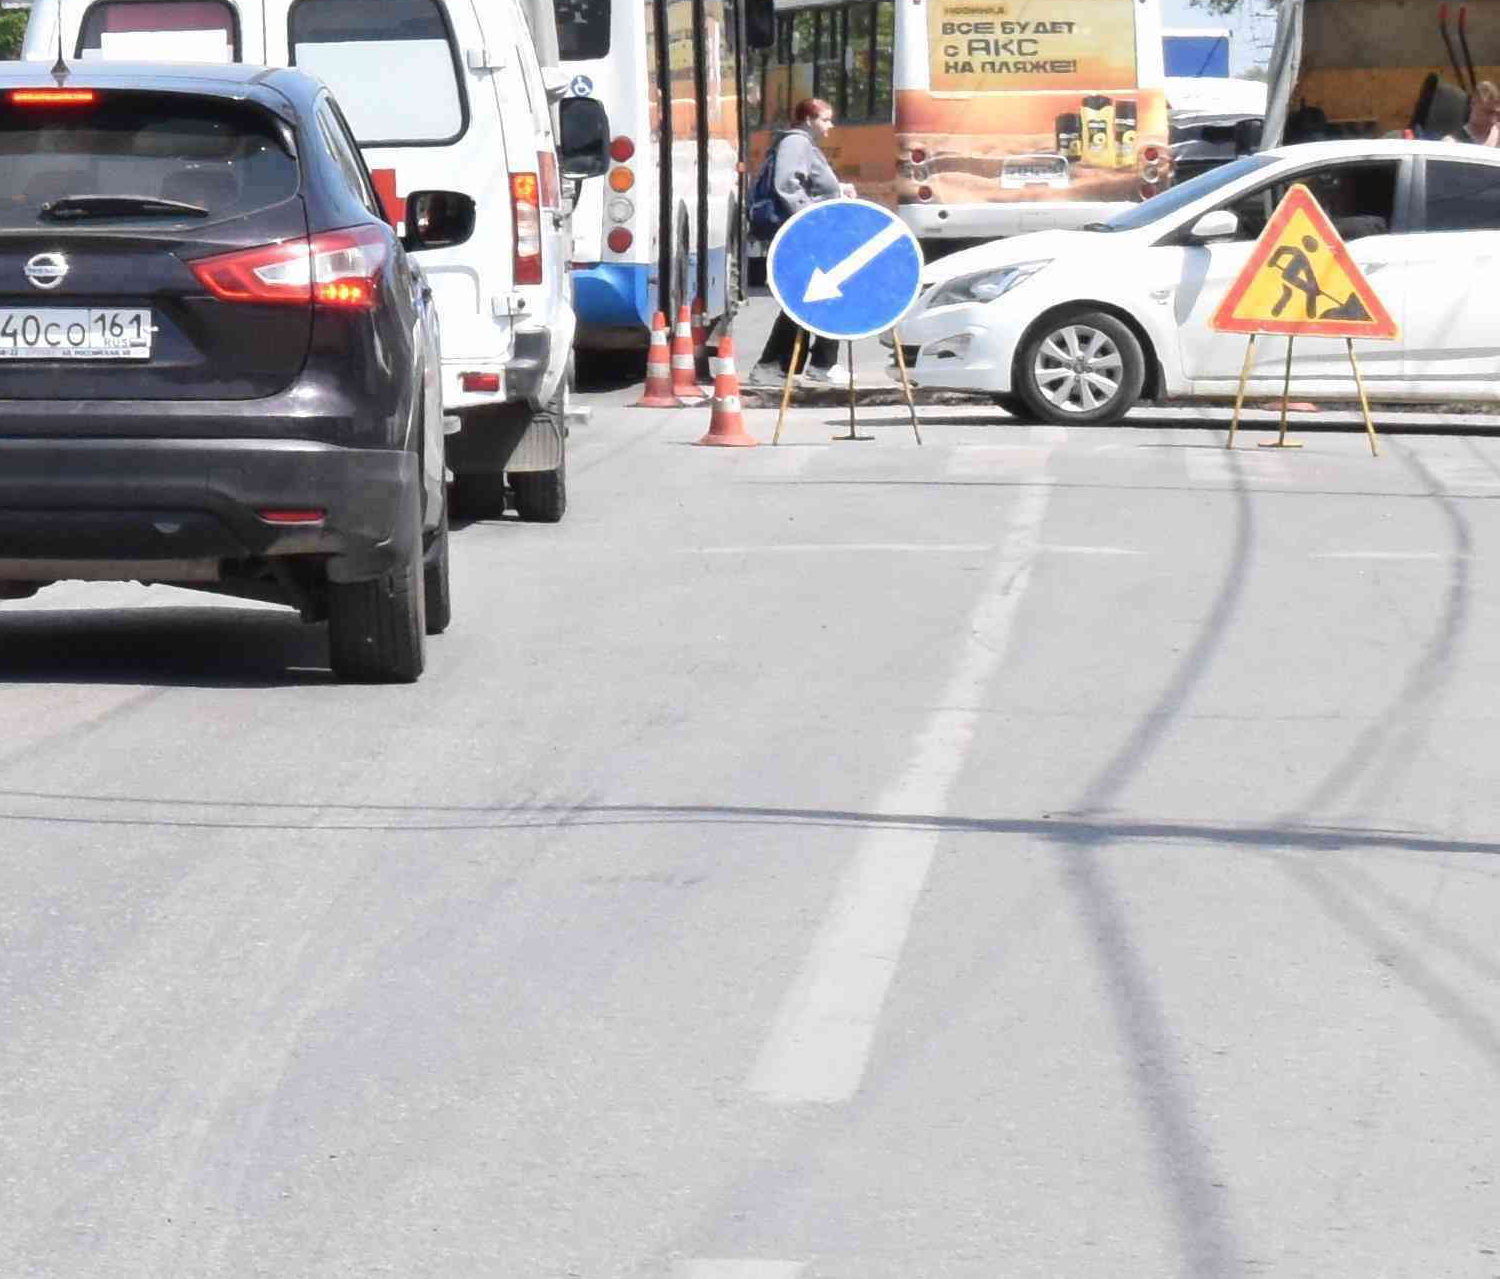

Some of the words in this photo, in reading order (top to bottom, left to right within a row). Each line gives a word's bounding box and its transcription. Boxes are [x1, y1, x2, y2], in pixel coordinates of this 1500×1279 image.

[941, 21, 995, 34] ВСЕ
[944, 61, 974, 74] НА
[980, 59, 1077, 74] ПЛЯЖЕ!
[93, 313, 143, 338] 161
